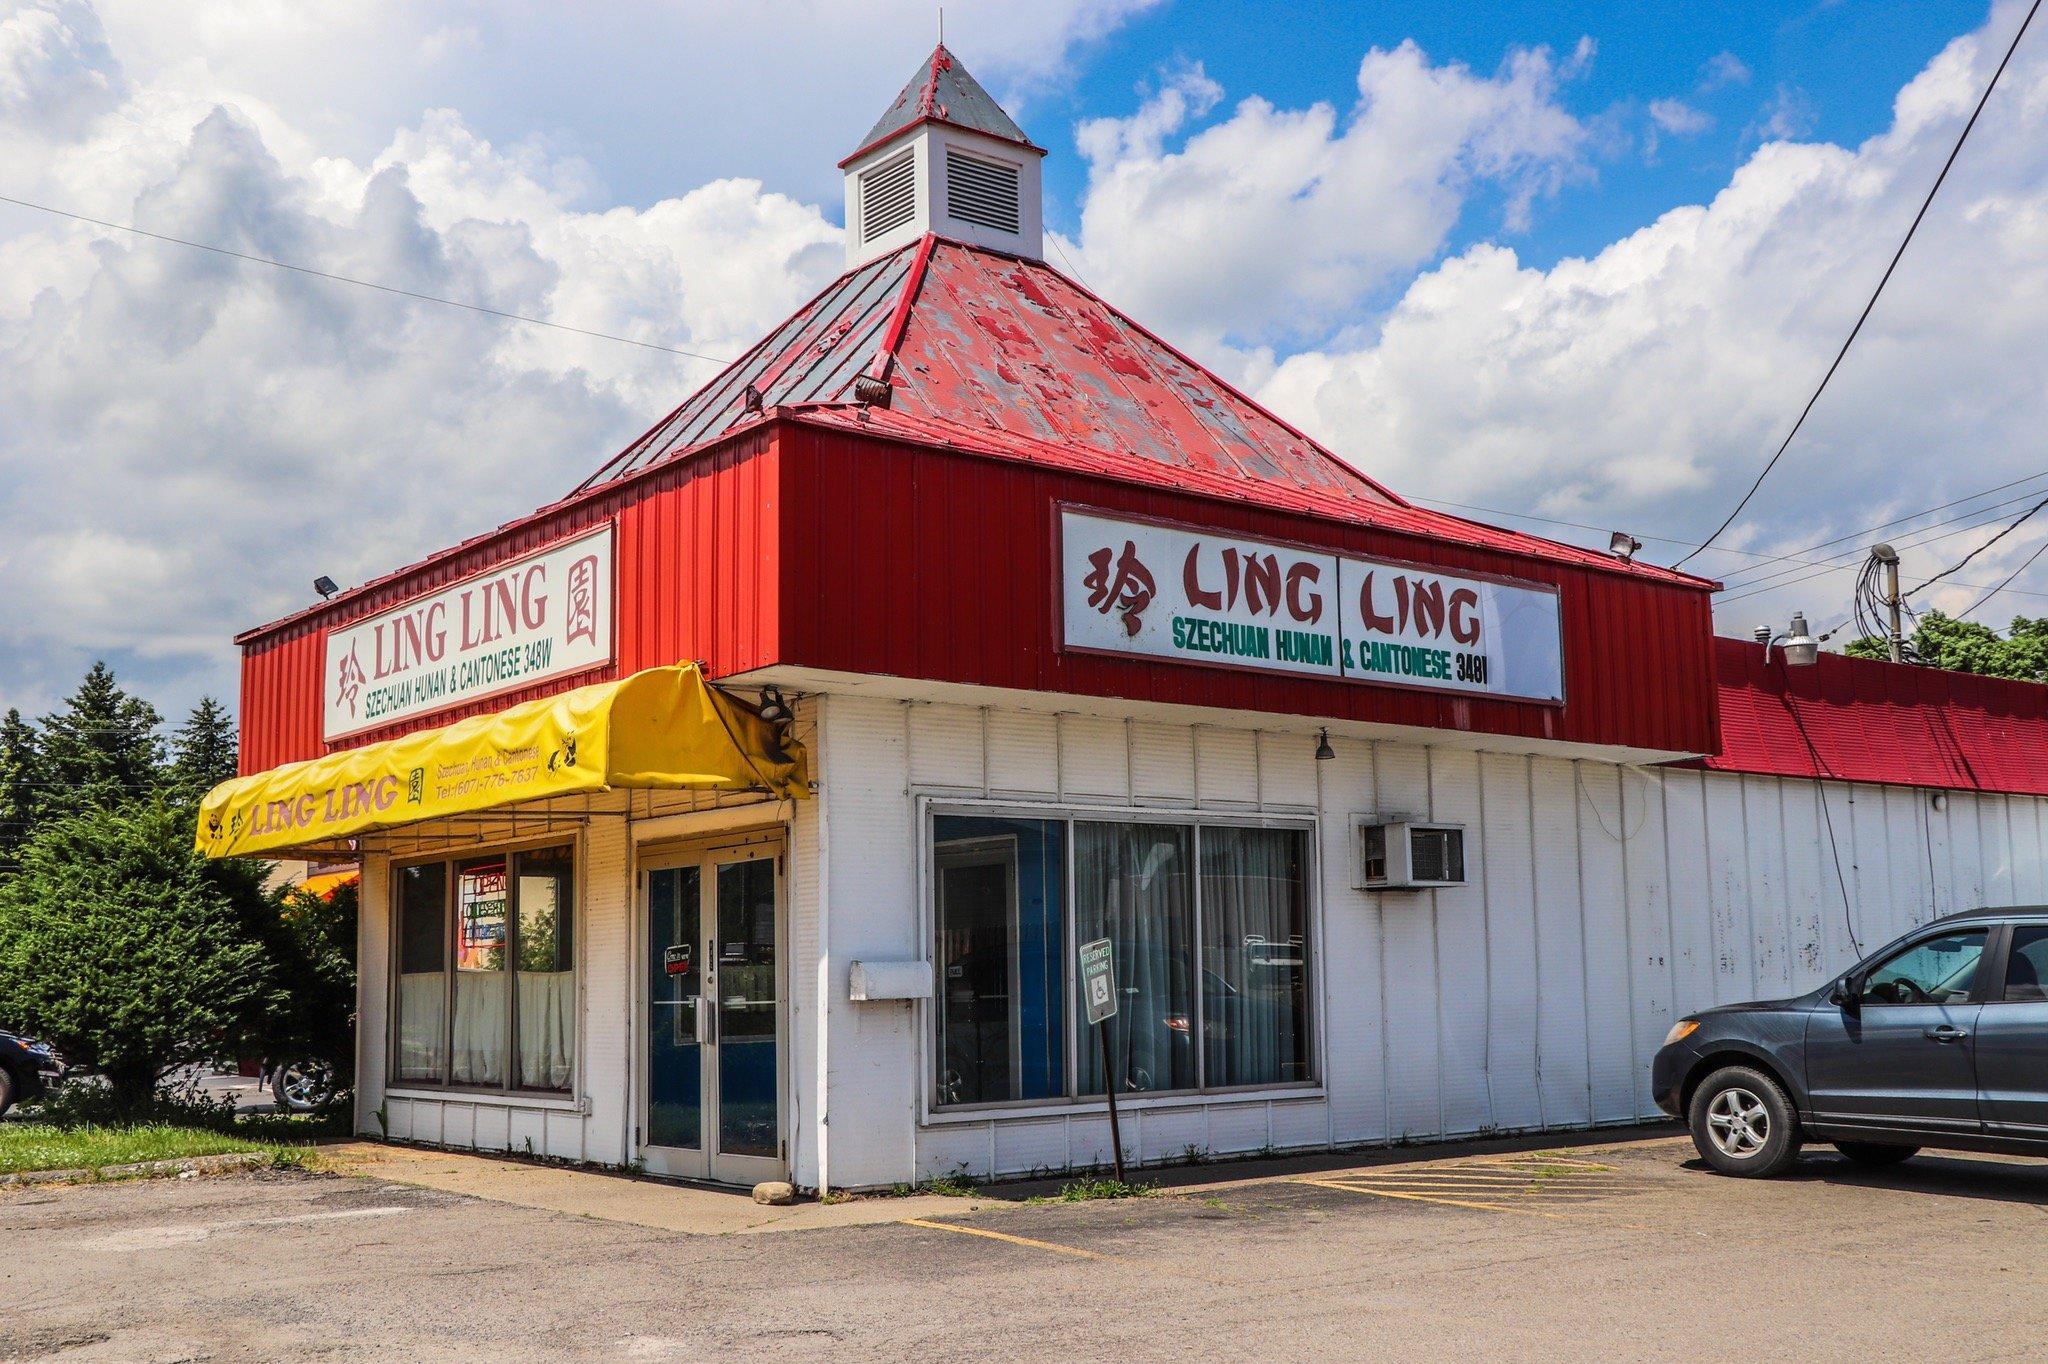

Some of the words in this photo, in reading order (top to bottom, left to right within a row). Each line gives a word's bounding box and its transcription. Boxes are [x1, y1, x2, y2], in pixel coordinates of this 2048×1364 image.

[373, 600, 447, 680] LING
[460, 562, 548, 652] LING
[1183, 542, 1323, 626] LING
[1360, 570, 1481, 647] LING
[365, 683, 412, 720] SZECHUAN
[415, 668, 447, 702] HUNAN
[450, 668, 457, 694] &
[460, 646, 520, 689] CANTONESE
[524, 637, 553, 674] 348W
[1172, 616, 1269, 660] SZECHUAN
[1276, 629, 1333, 667] HUNAN
[1343, 638, 1354, 669] &
[1359, 640, 1452, 681] CANTONESE
[471, 756, 492, 772] Hunan
[503, 746, 539, 766] Cantonese
[249, 793, 315, 837] LING
[323, 774, 399, 823] LING
[1082, 946, 1110, 964] RESERVED
[1086, 960, 1109, 977] PARKING
